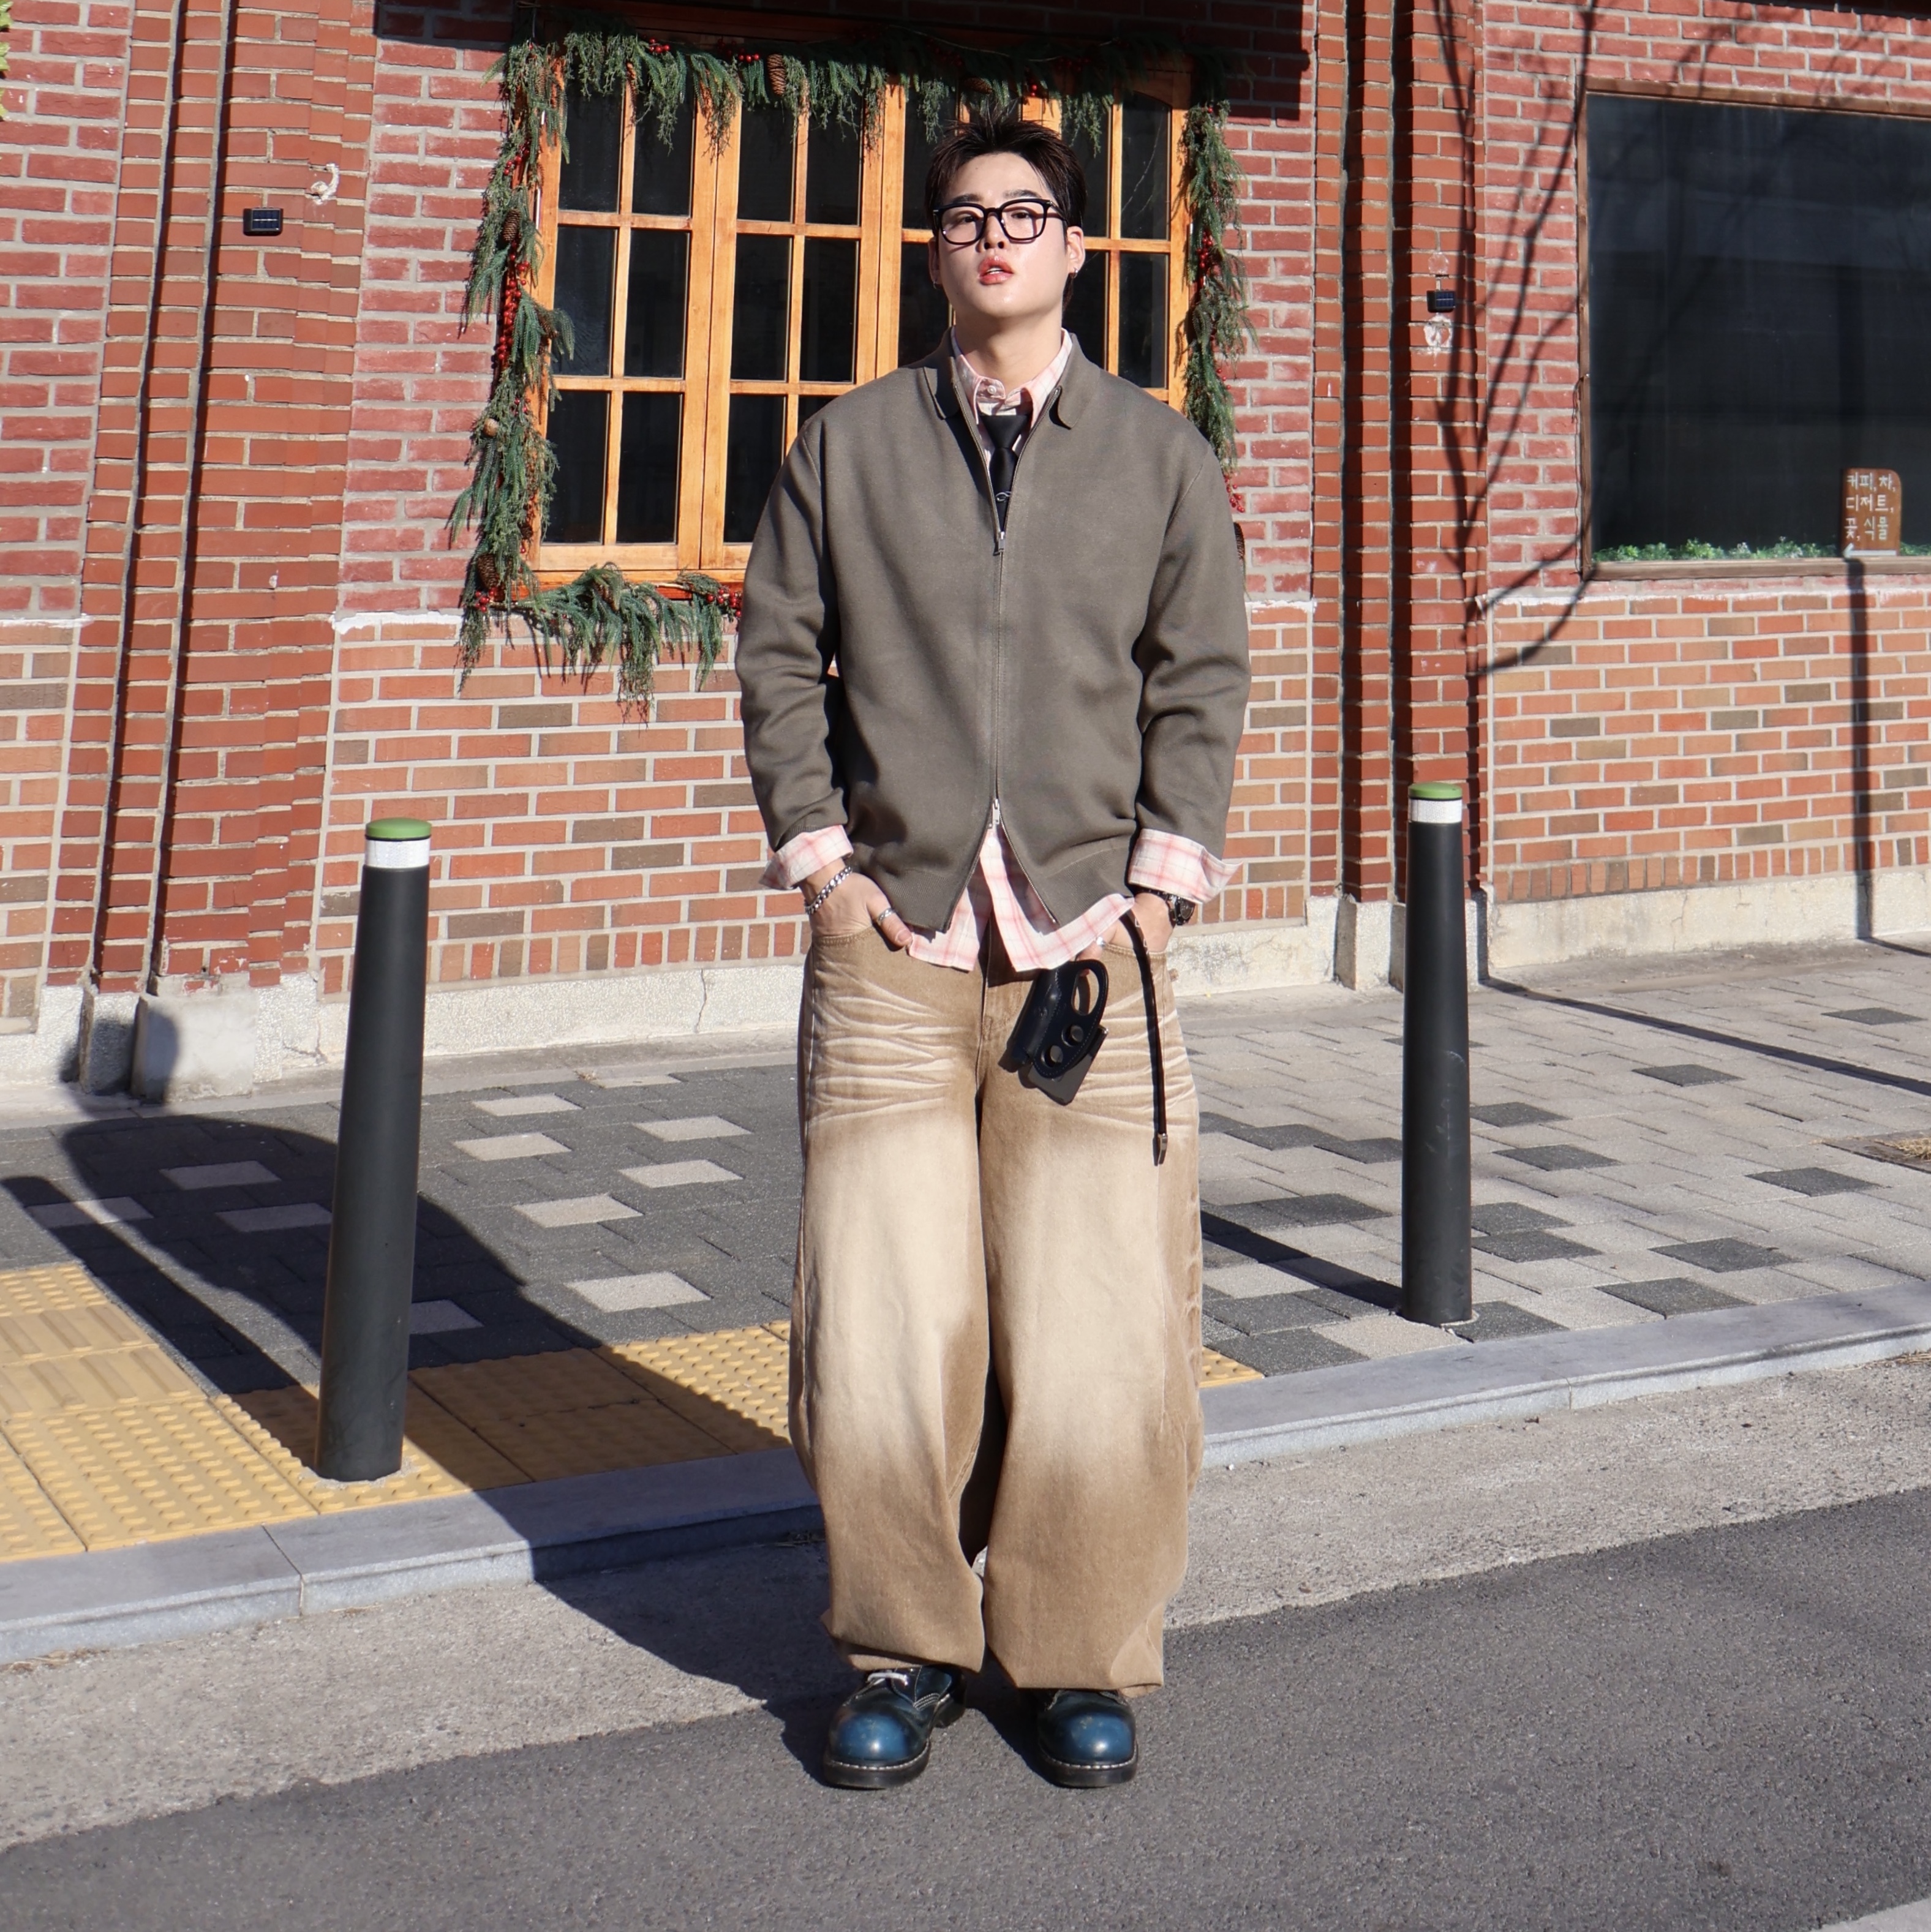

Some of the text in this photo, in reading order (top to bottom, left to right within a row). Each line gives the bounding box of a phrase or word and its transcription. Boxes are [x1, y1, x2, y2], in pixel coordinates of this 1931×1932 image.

[1846, 472, 1896, 492] 커피, 차,
[1846, 494, 1894, 513] 디저트,
[1844, 516, 1888, 541] 꽃, 식물
